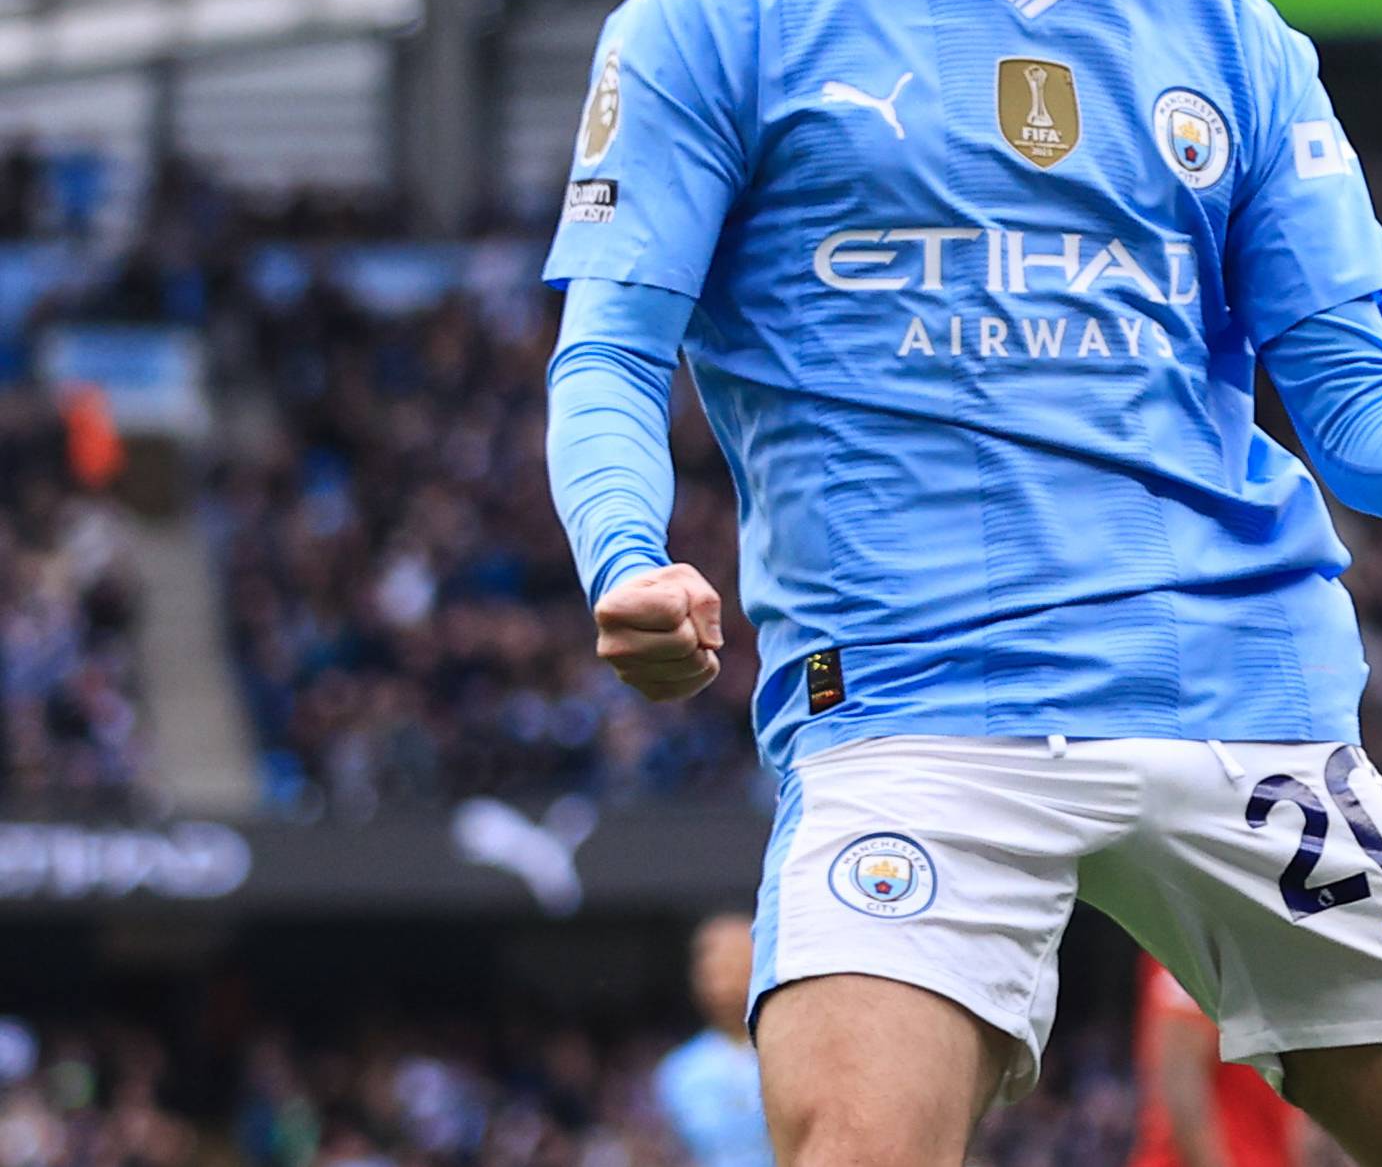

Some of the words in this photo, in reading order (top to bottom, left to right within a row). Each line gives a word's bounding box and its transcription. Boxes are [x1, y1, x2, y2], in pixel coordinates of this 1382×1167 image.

[1159, 96, 1223, 135] MANCHESTER
[1022, 126, 1060, 143] FIFA
[898, 315, 1176, 359] AIRWAYS
[843, 841, 928, 872] MANCHESTER
[866, 902, 899, 913] CITY
